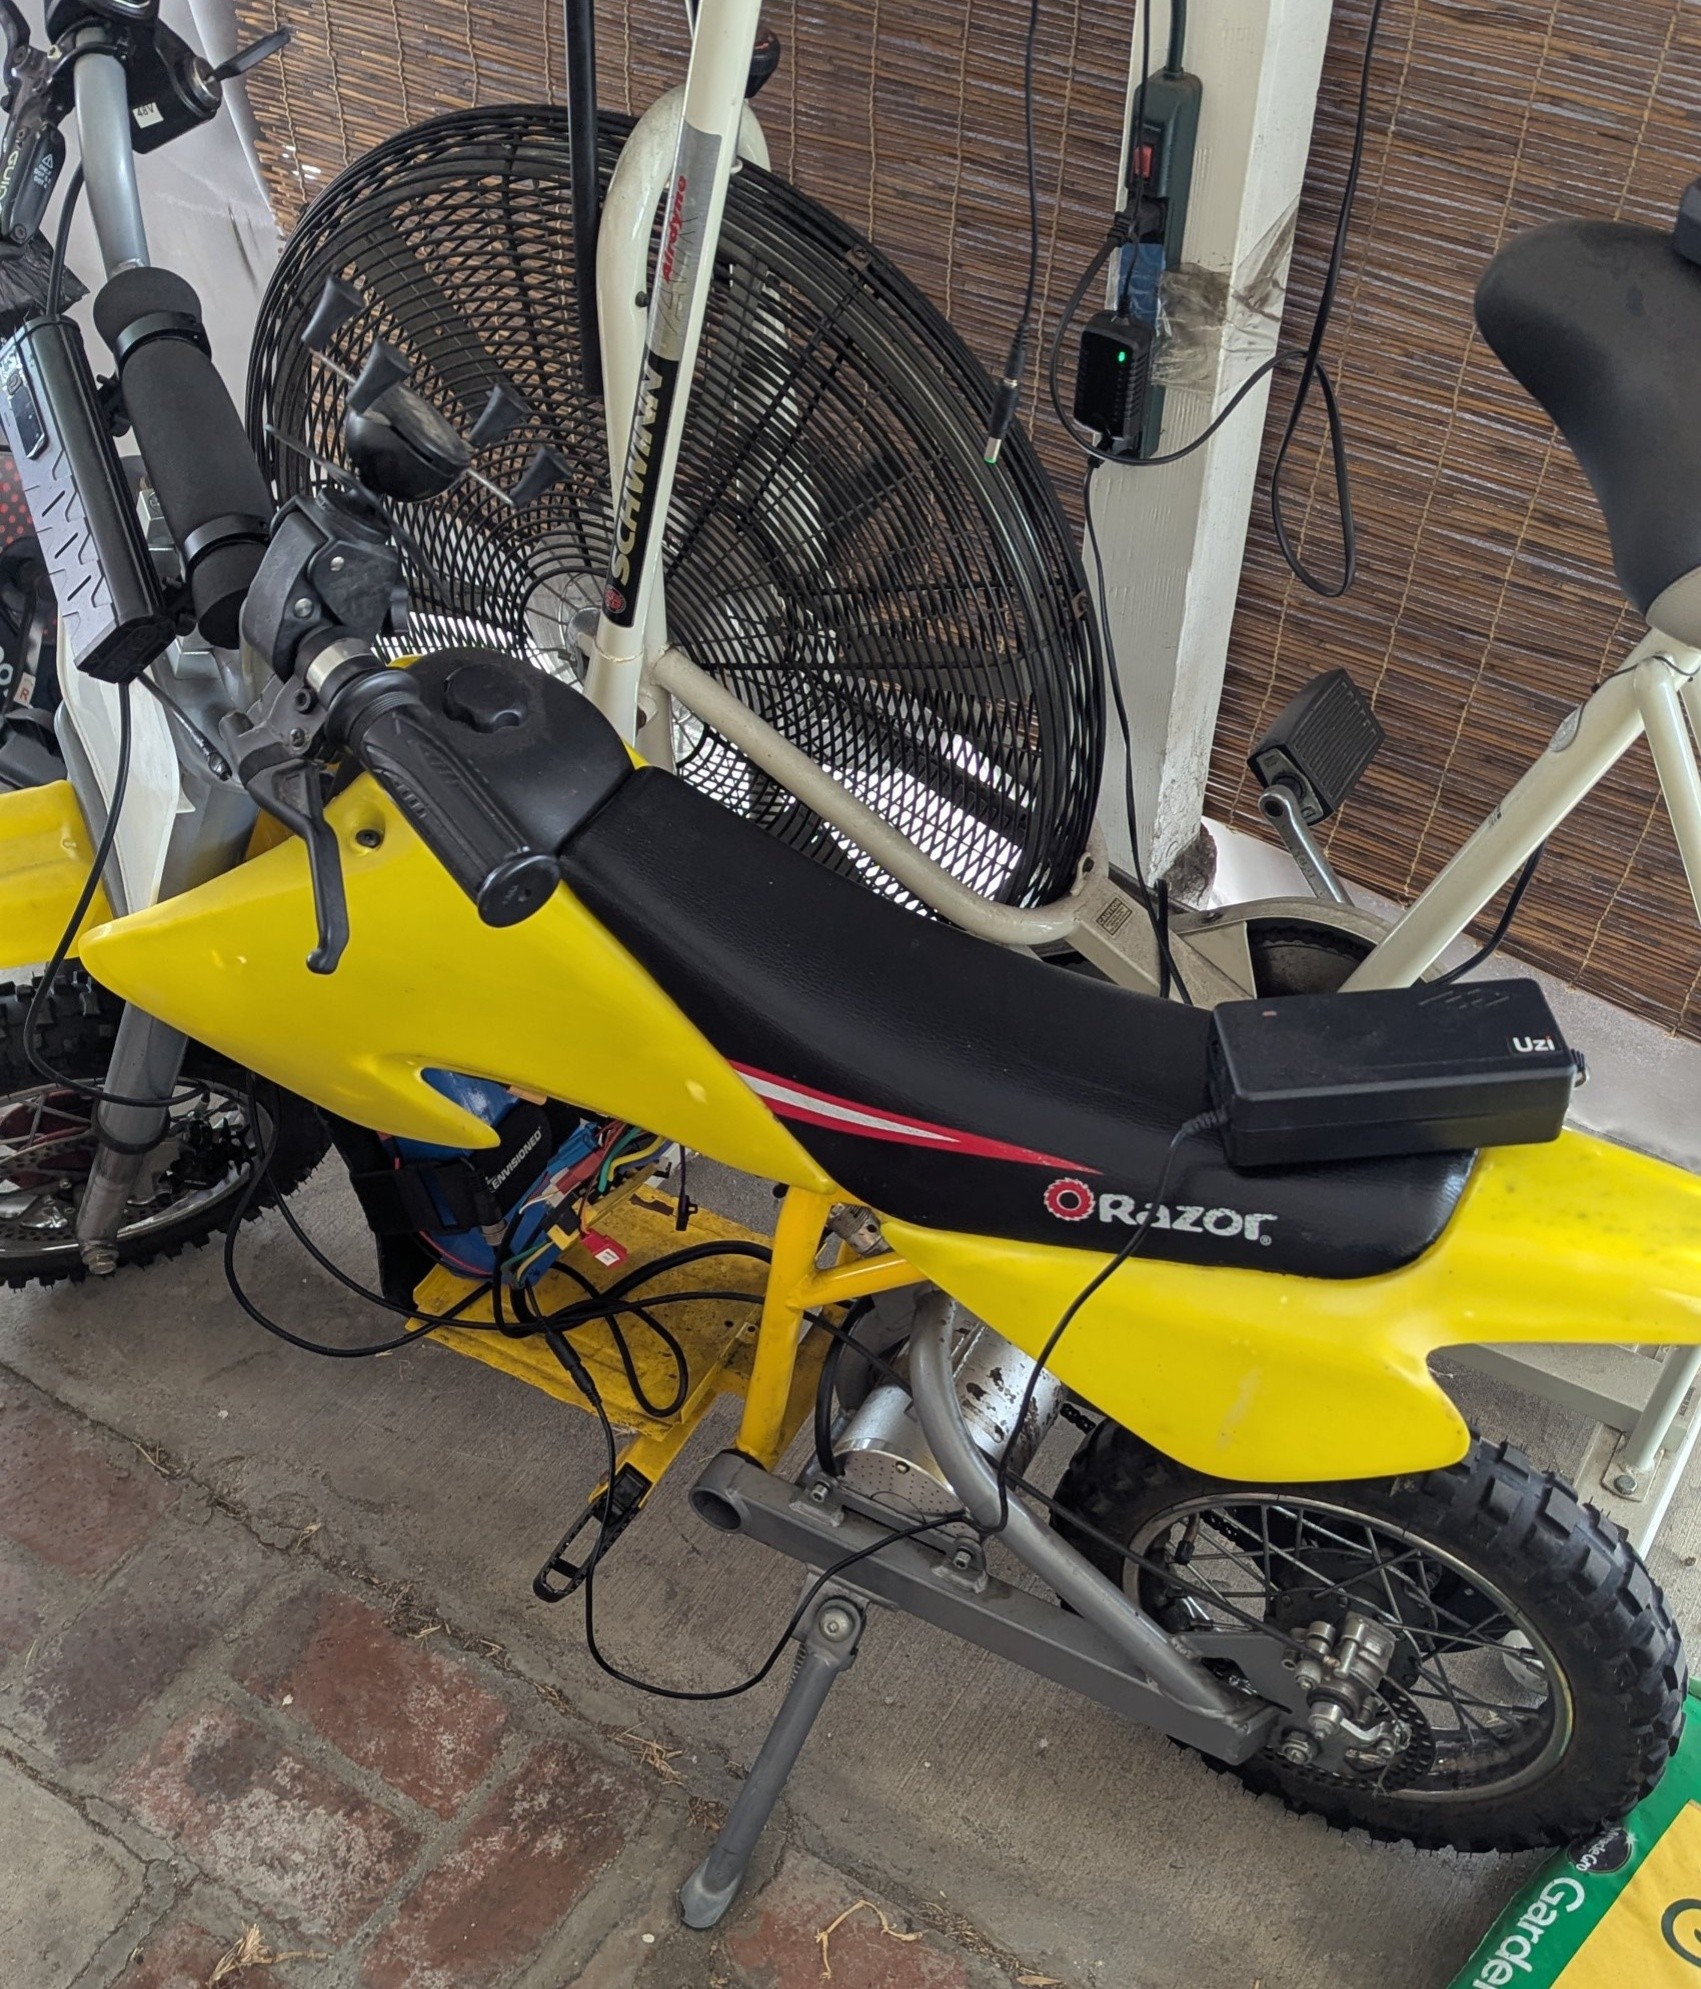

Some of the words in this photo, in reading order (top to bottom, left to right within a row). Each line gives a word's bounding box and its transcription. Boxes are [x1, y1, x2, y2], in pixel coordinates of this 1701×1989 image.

[611, 360, 663, 587] SCHWINN
[1099, 898, 1123, 924] CAUTION
[1512, 1035, 1556, 1053] Uzi
[491, 1128, 542, 1190] ENVISIONED
[1099, 1192, 1278, 1241] Razor
